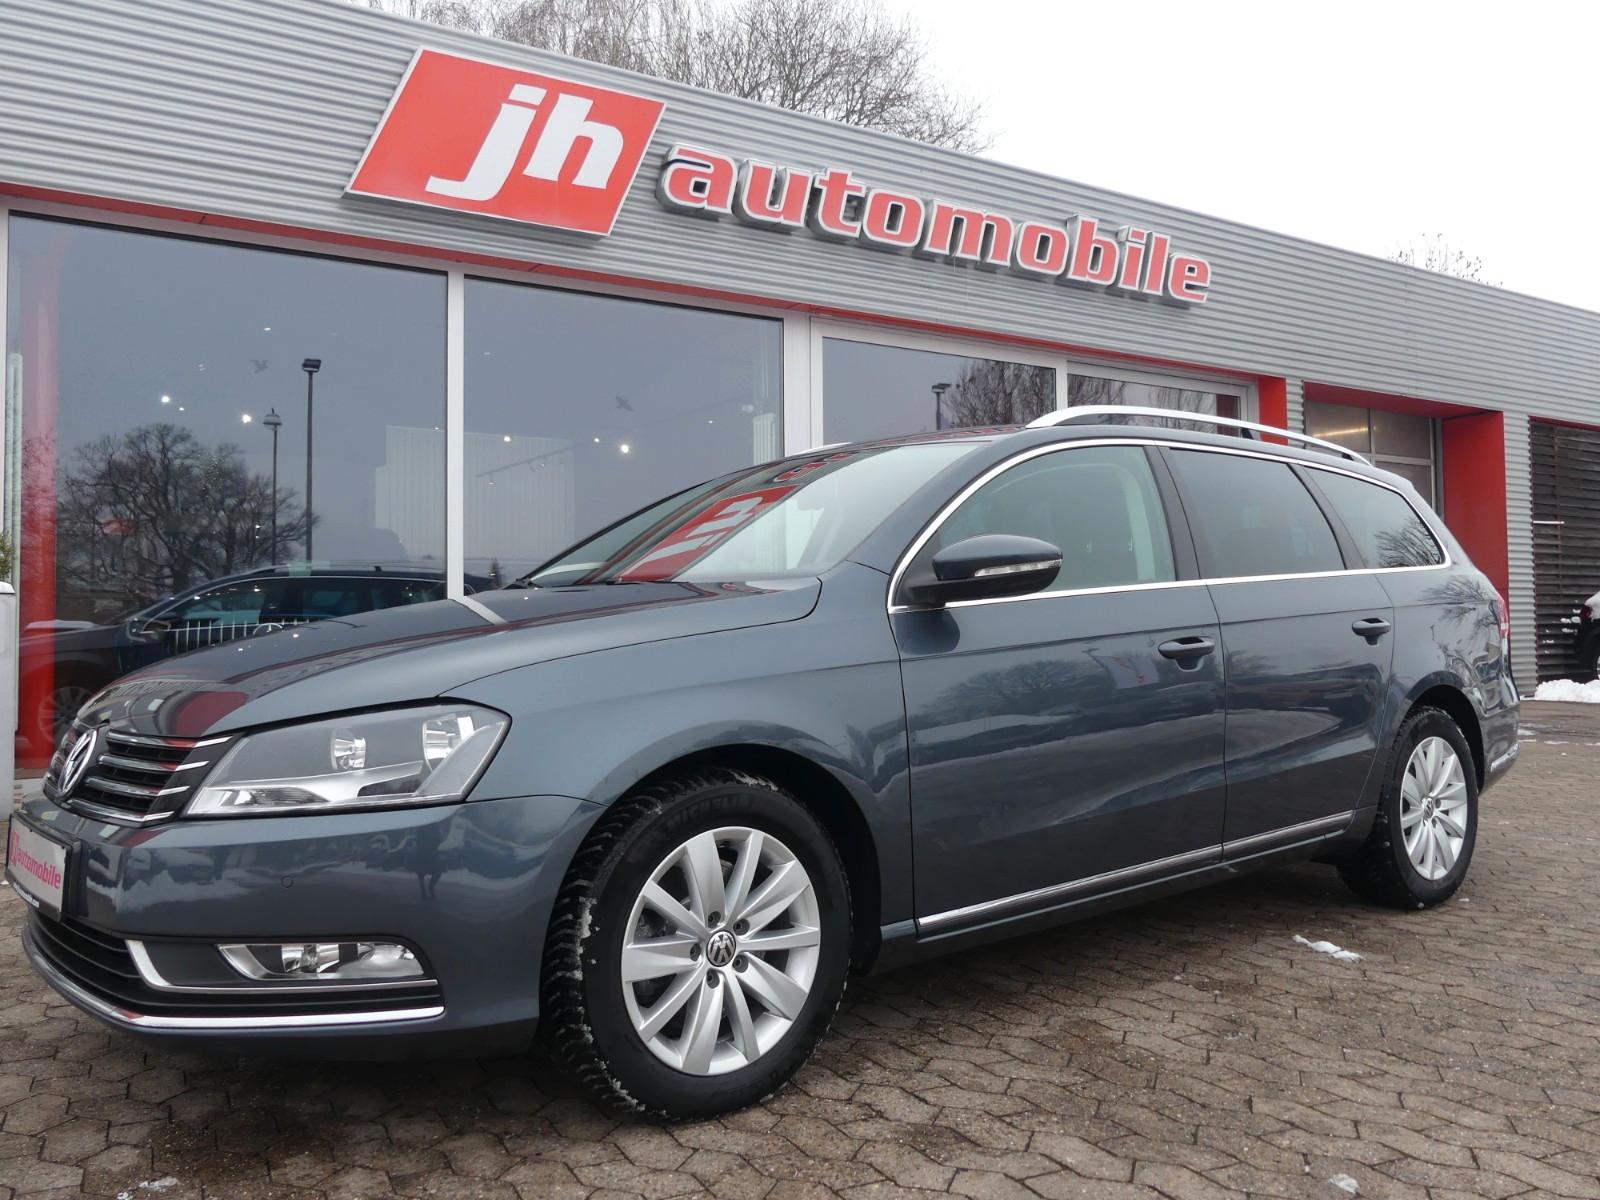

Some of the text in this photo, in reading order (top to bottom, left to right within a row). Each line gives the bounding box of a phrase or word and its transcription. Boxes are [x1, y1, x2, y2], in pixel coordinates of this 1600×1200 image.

[425, 84, 624, 201] jh
[657, 143, 1212, 303] automobile
[666, 793, 753, 828] MICHELIN
[17, 847, 62, 890] automobile
[707, 930, 735, 966] VW
